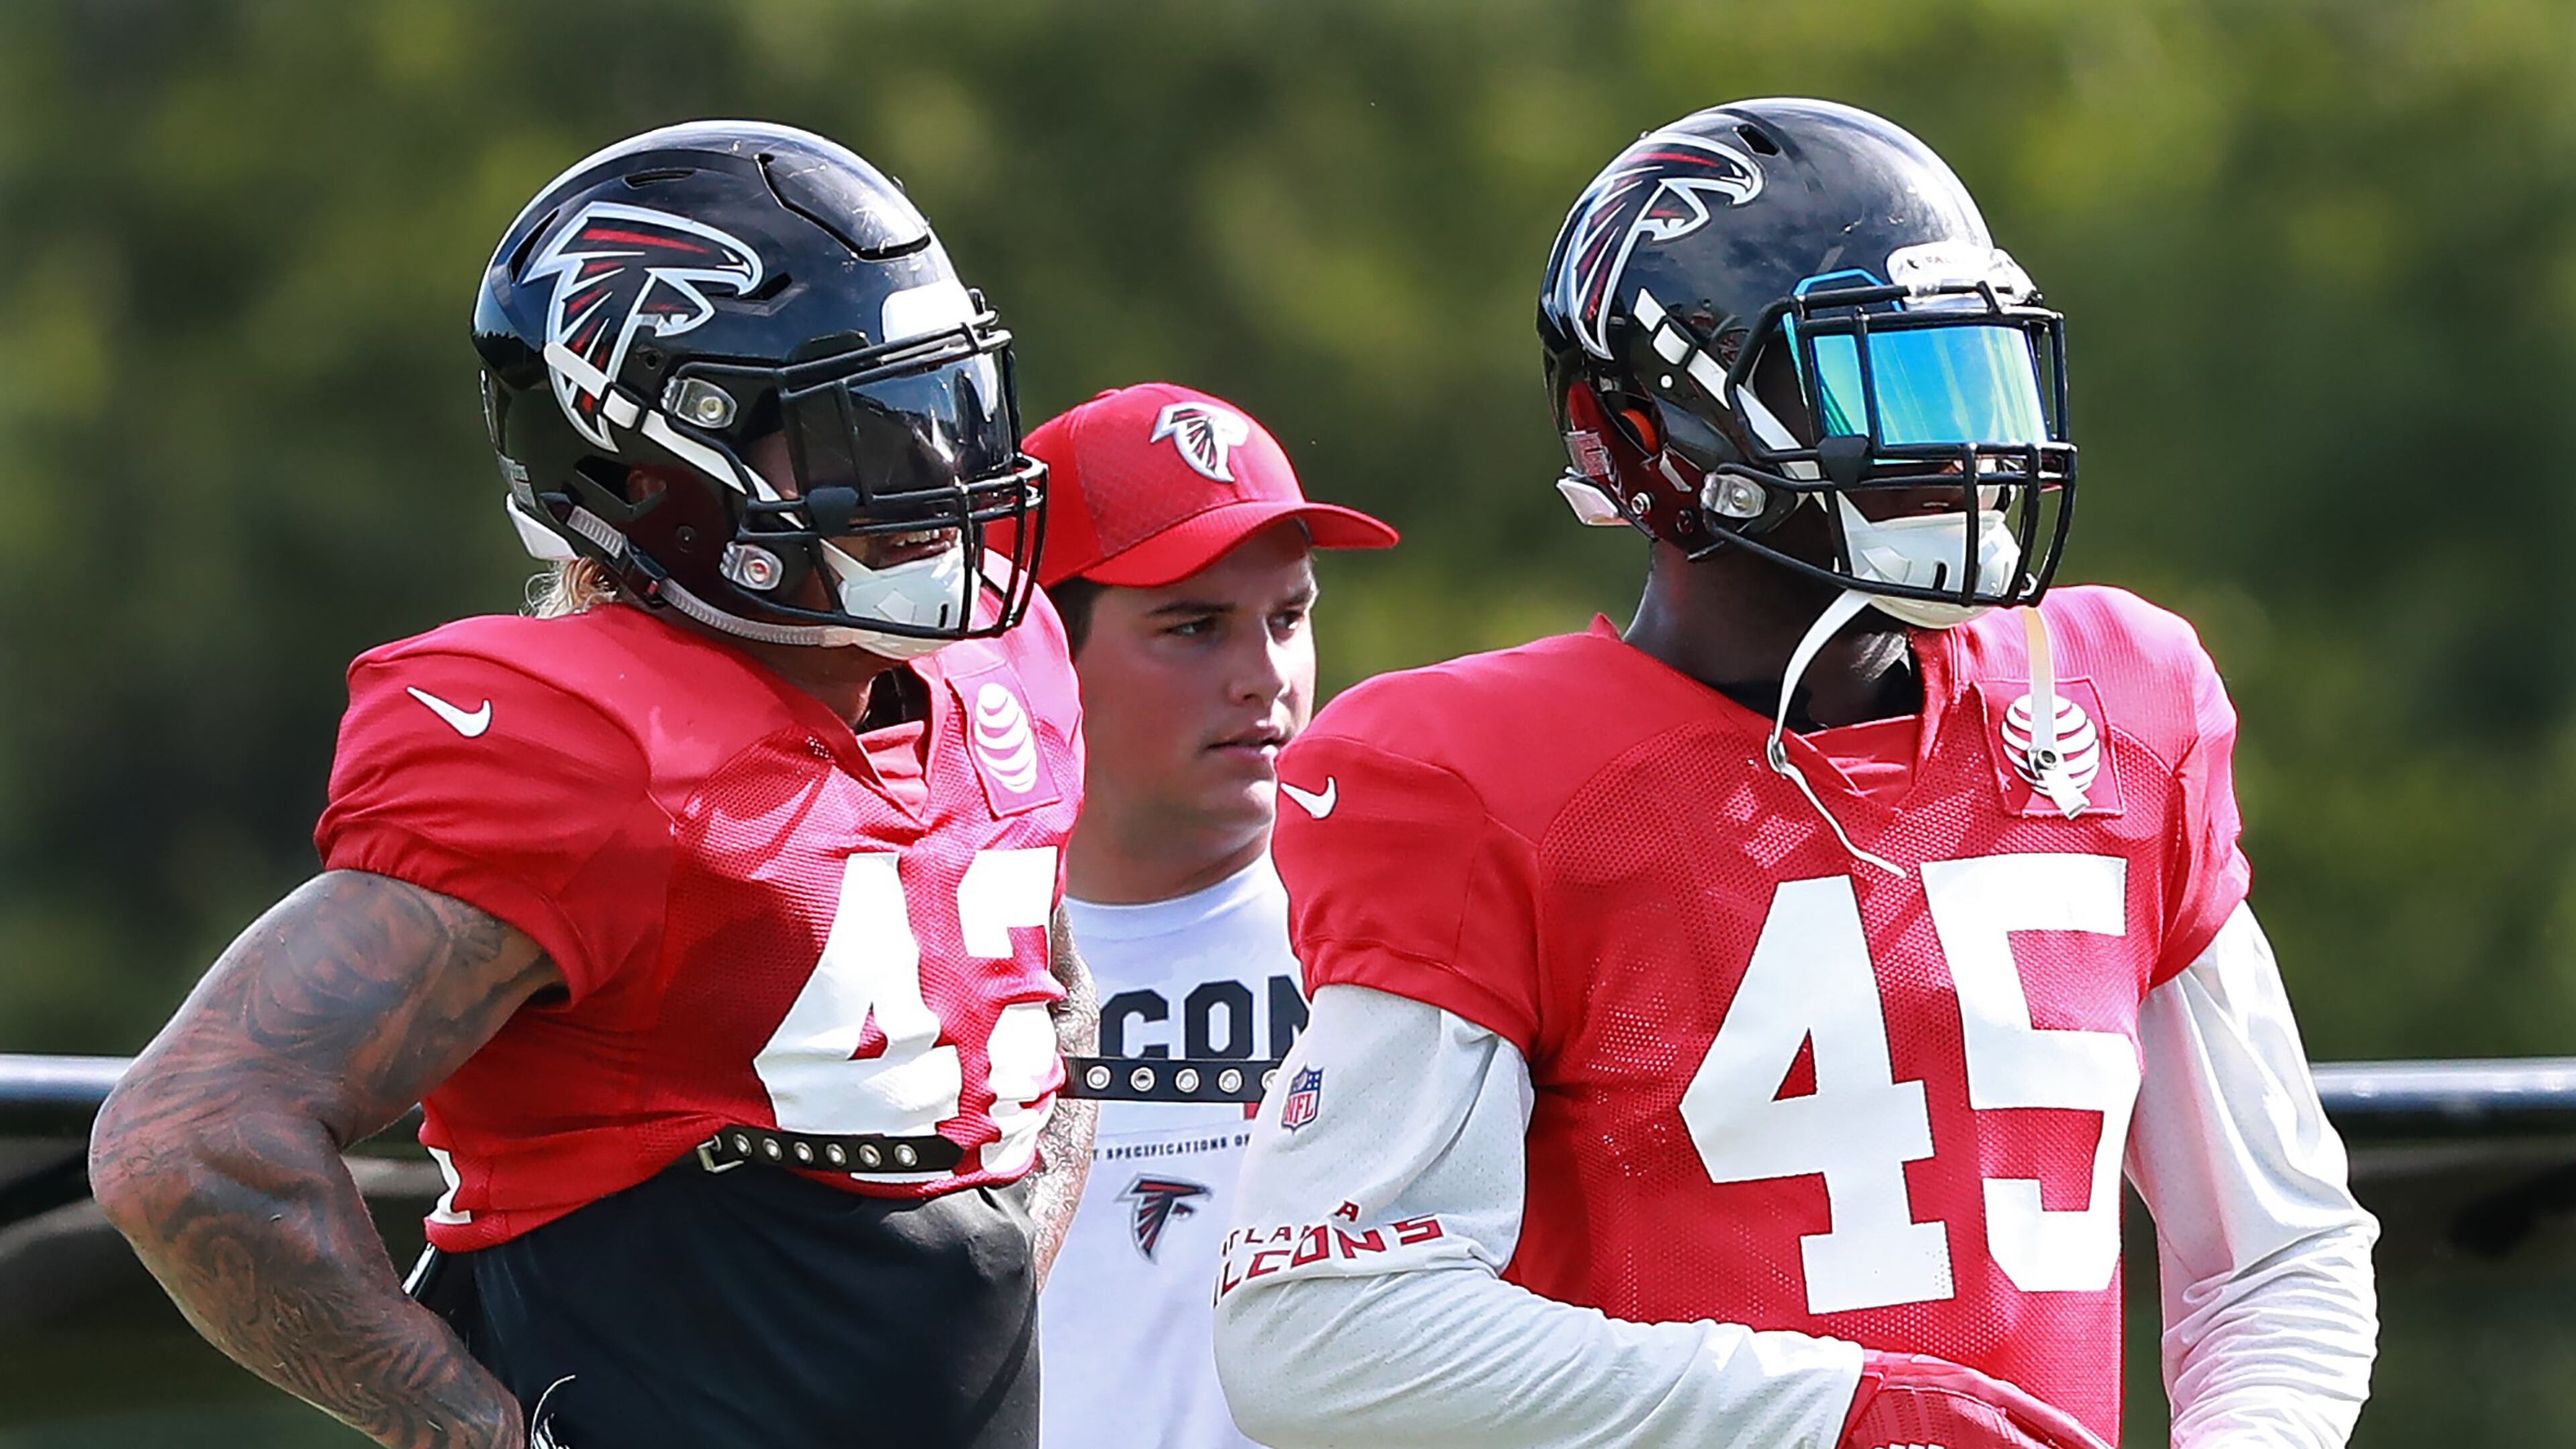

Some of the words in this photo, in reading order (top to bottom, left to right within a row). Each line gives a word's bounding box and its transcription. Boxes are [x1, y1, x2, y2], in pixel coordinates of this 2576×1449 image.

[1679, 853, 2141, 1314] 45
[1284, 1093, 1314, 1124] NFL
[1106, 1136, 1228, 1160] SPECIFICATIONS
